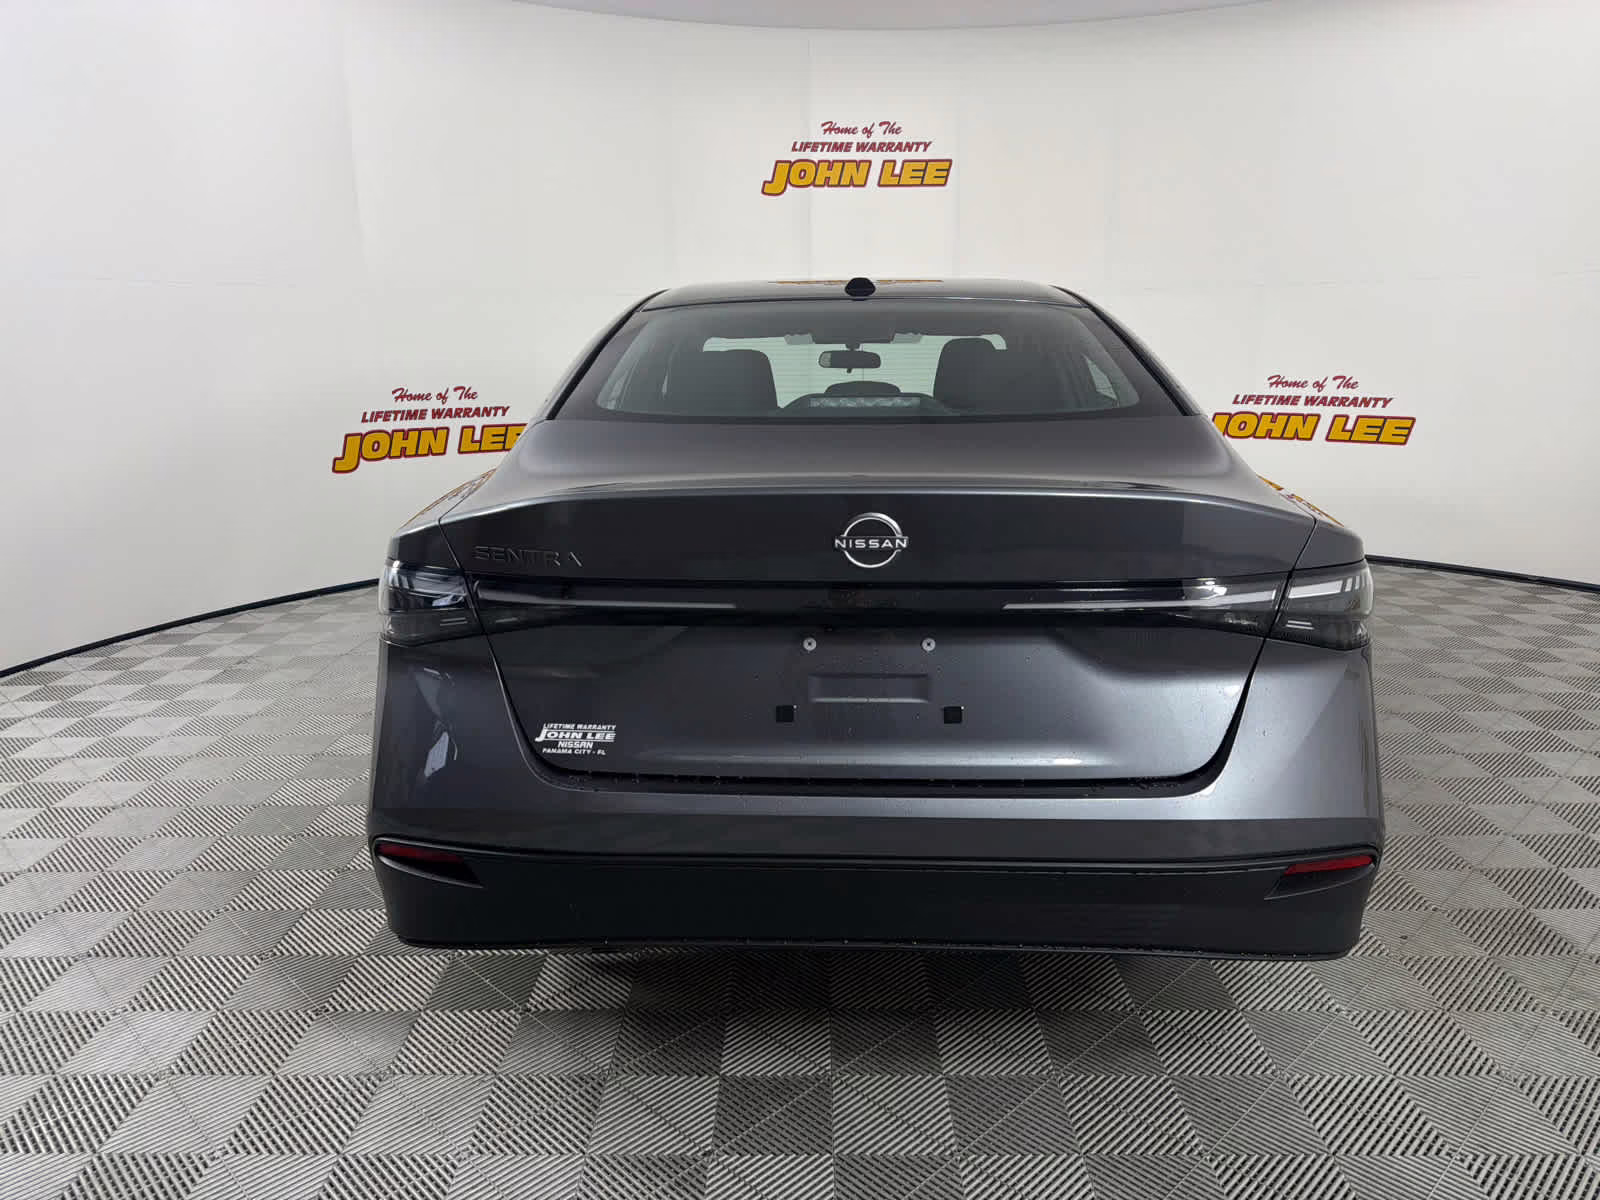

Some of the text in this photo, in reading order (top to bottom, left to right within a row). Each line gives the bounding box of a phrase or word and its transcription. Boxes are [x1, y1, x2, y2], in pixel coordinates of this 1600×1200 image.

[821, 121, 902, 138] Home of The
[791, 141, 932, 152] LIFETIME WARRANTY
[761, 159, 952, 196] JOHN LEE
[1268, 375, 1359, 392] Home of The
[392, 386, 478, 404] Home of The
[1232, 395, 1393, 408] LIFETIME WARRANTY
[361, 406, 510, 423] LIFETIME WARRANTY
[1325, 414, 1416, 445] LEE
[332, 427, 450, 474] JOHN
[834, 539, 907, 549] NISSAN
[473, 545, 583, 568] SENTRA
[535, 729, 616, 742] JOHN LEE
